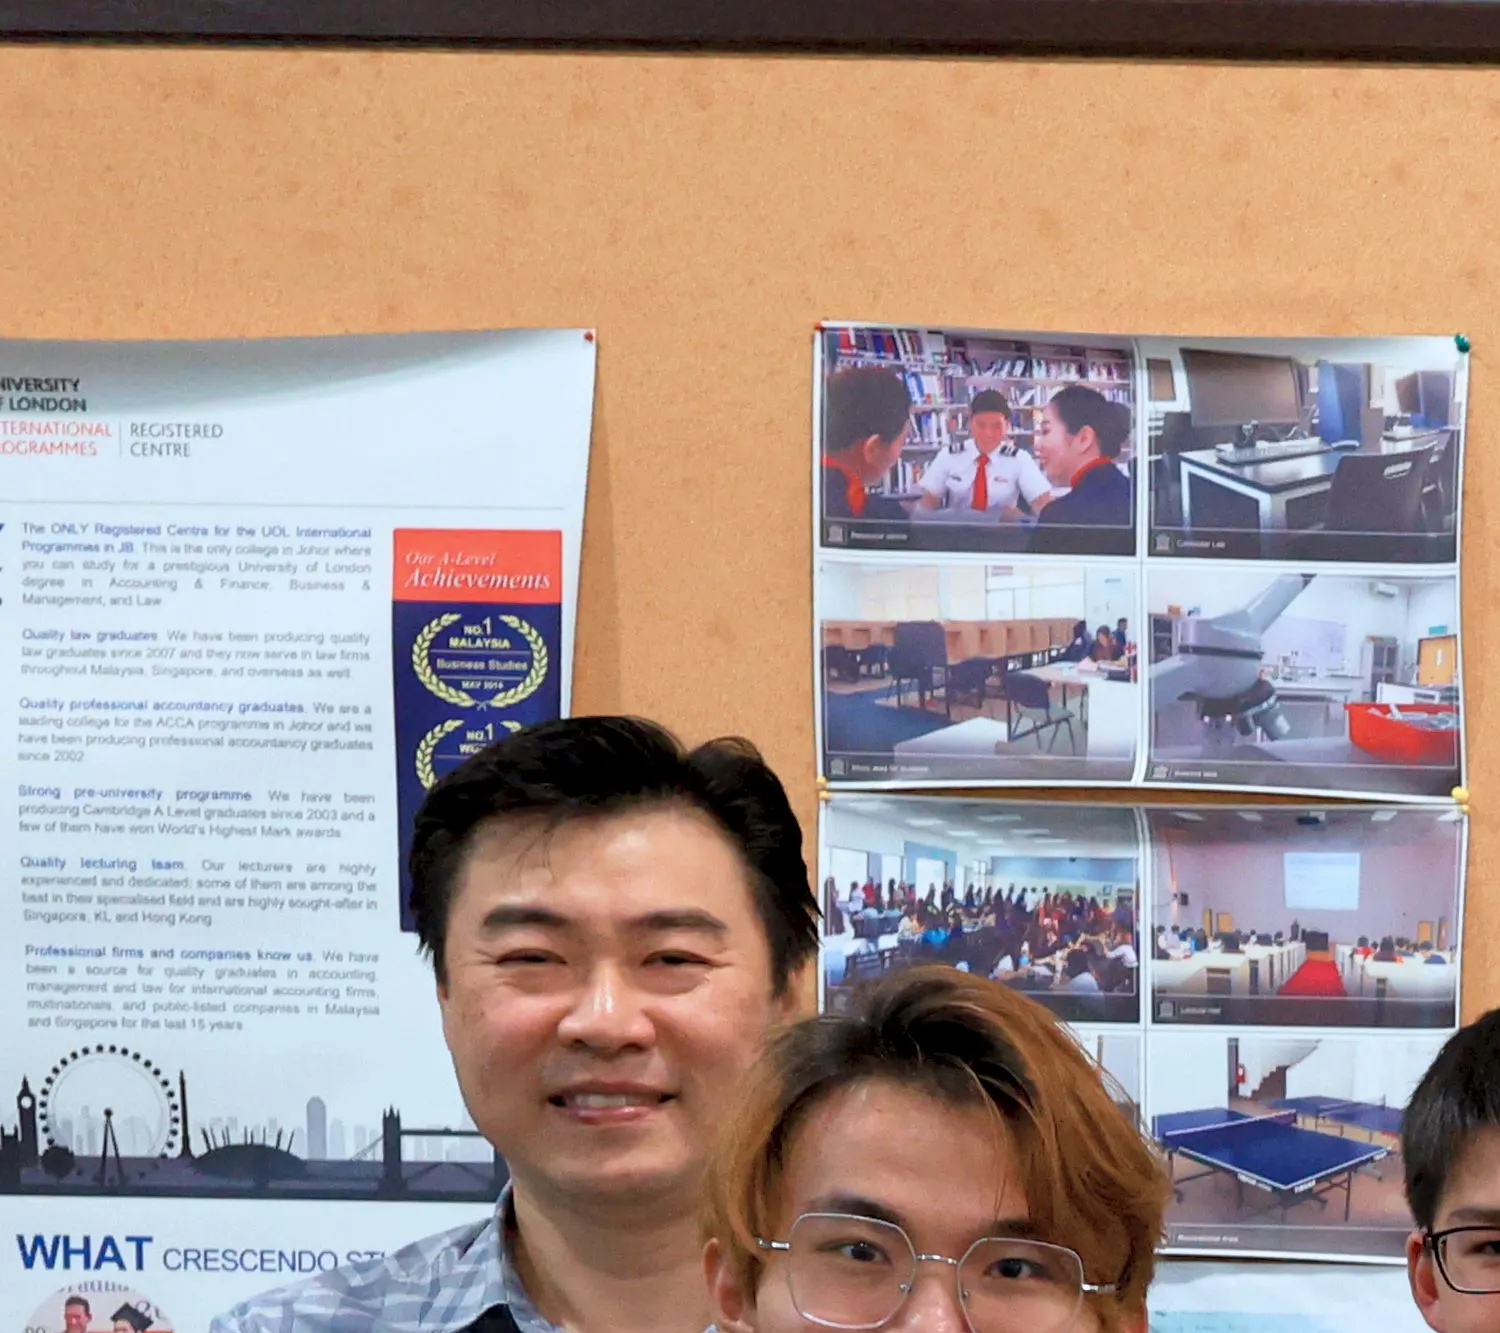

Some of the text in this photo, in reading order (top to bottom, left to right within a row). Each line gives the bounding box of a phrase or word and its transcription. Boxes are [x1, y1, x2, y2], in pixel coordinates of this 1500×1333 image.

[0, 377, 81, 393] IVERSITY
[9, 396, 87, 413] LONDON
[0, 420, 112, 437] TERNATIONAL
[129, 423, 224, 439] REGISTERED
[0, 440, 98, 457] OGRAMMES
[129, 442, 192, 458] CENTRE
[404, 551, 433, 566] Our
[404, 567, 552, 590] Achievements
[449, 637, 511, 649] MALAYSIA
[16, 1234, 338, 1274] WHAT CRESCENDO
